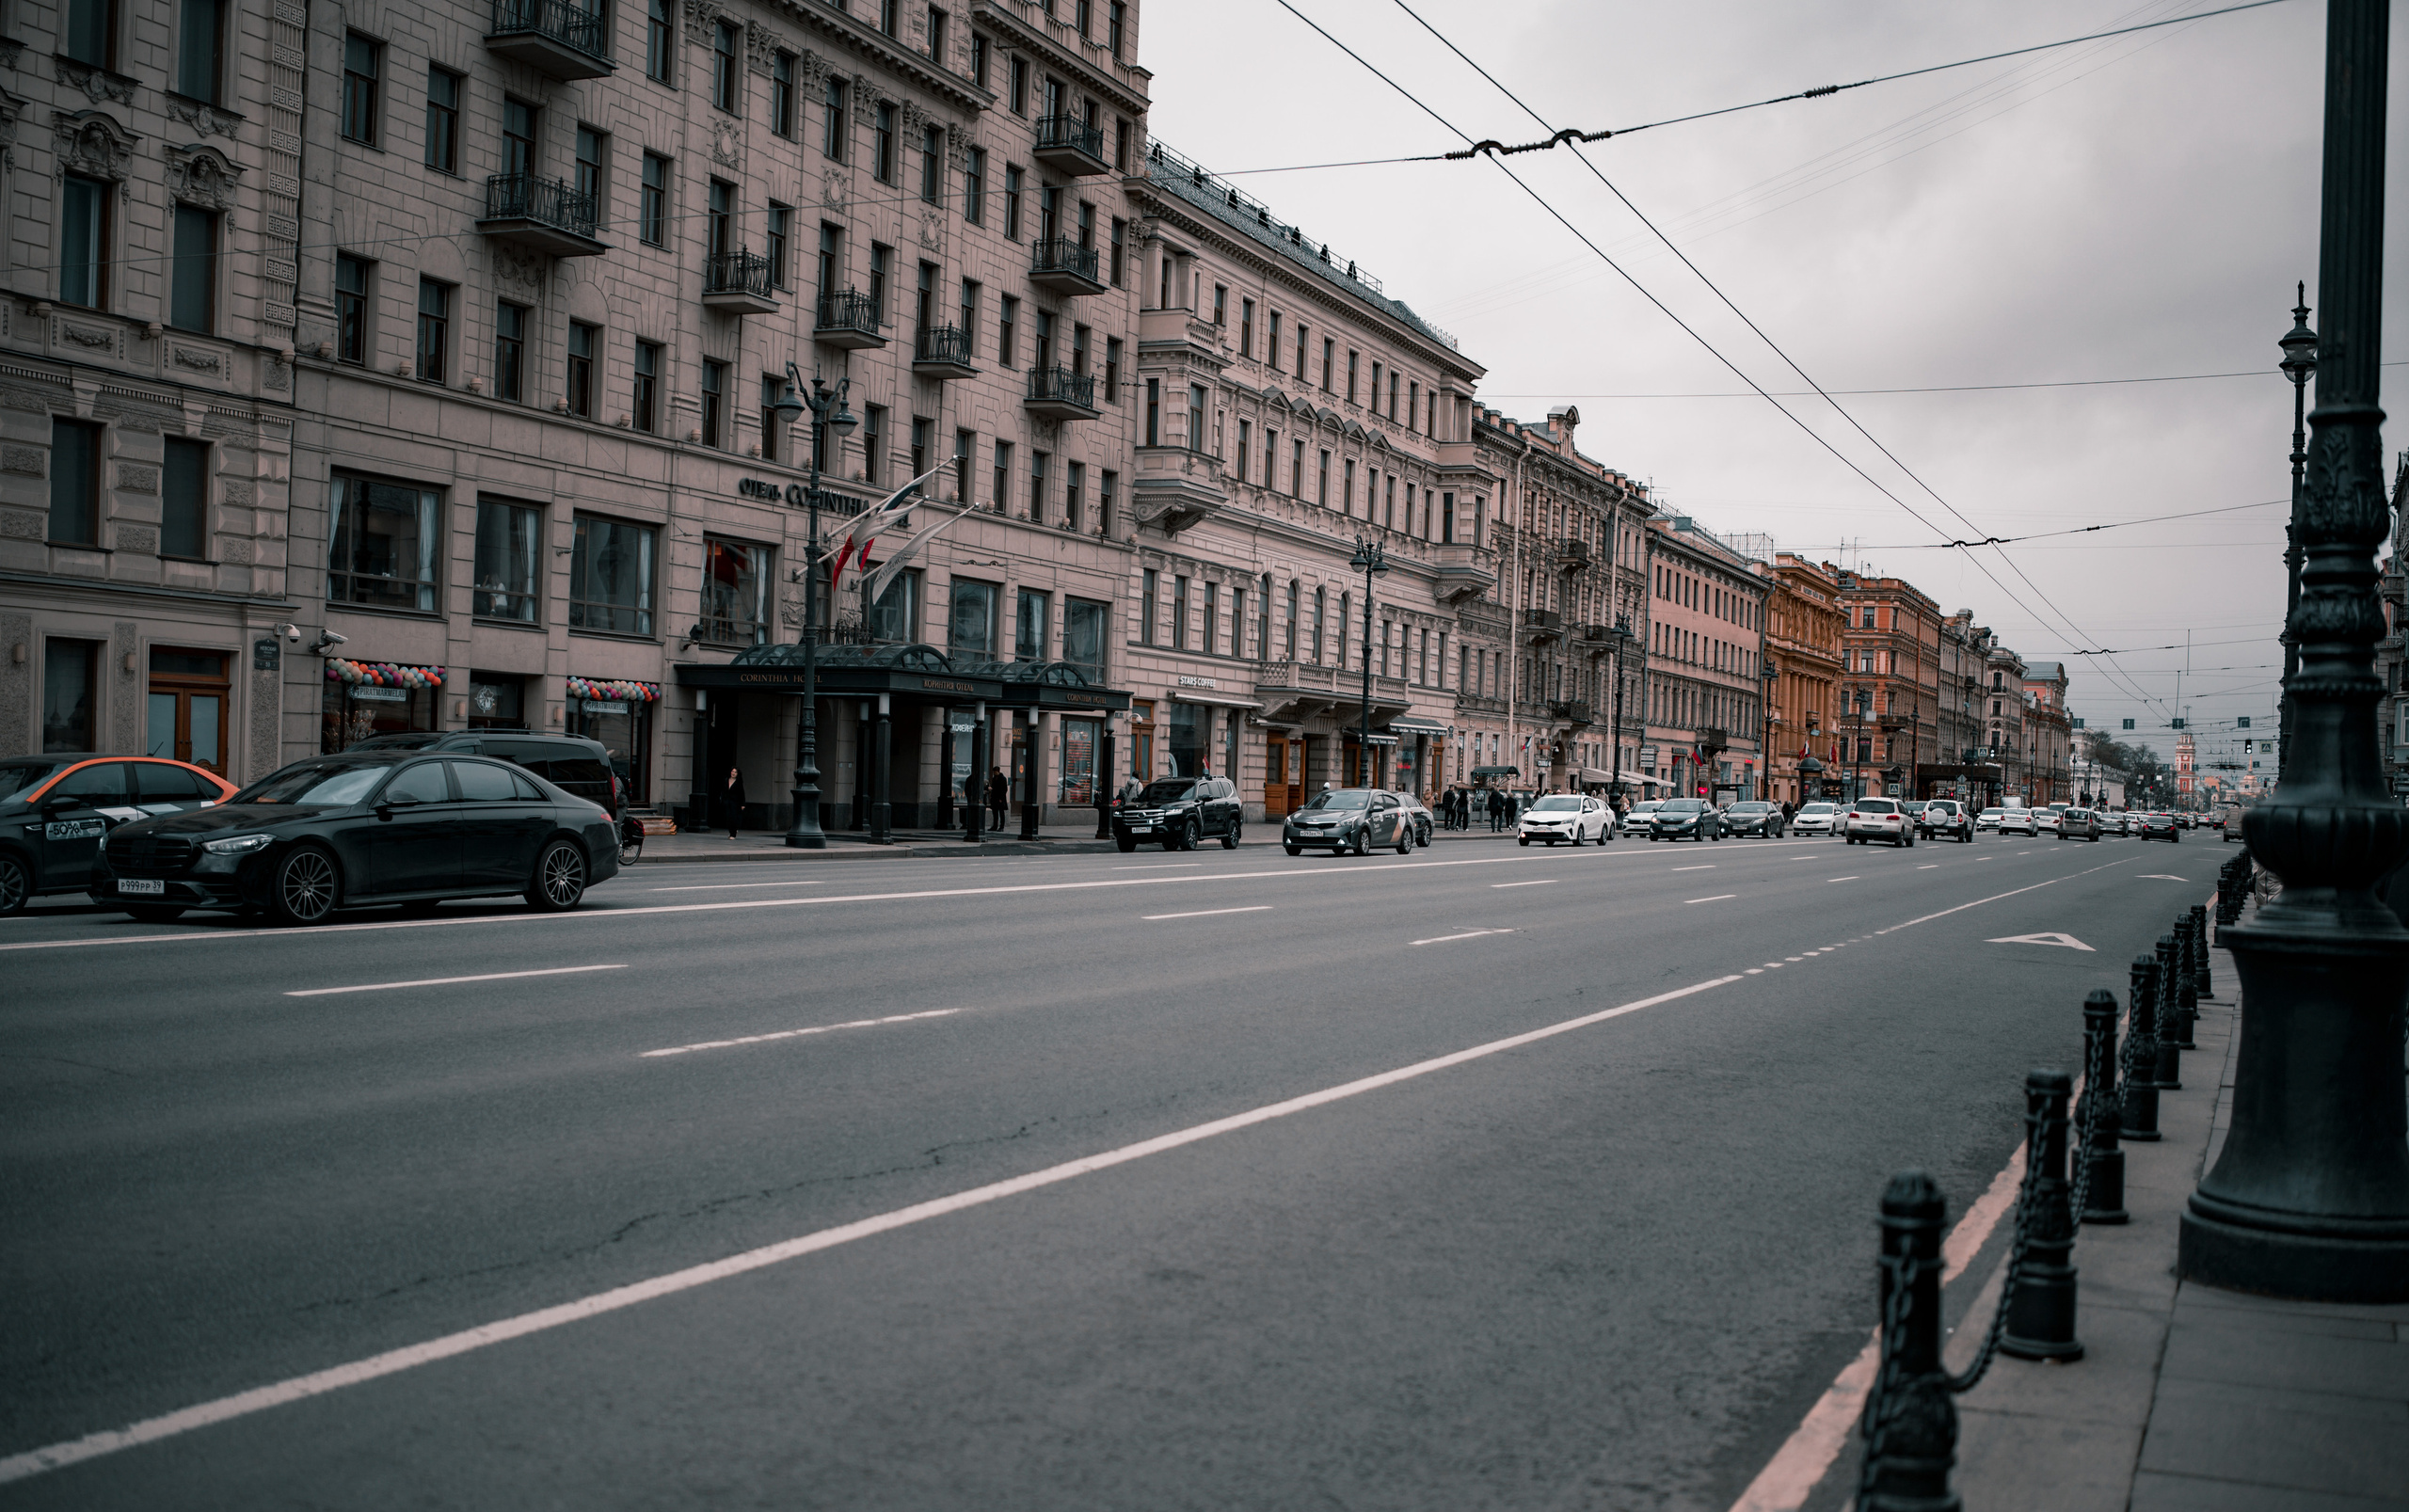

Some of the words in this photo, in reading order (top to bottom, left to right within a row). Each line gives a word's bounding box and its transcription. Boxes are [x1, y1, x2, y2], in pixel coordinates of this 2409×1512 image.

[739, 477, 782, 500] ОТЕЛЬ
[785, 483, 870, 518] COINTHIA
[740, 674, 789, 682] CORINTHIA
[793, 675, 822, 683] HOEL
[1180, 676, 1197, 686] STARS
[1197, 677, 1217, 688] COFFEE
[923, 679, 954, 690] КОРИНТИЯ
[956, 682, 974, 692] ОТЕЛЬ
[359, 687, 406, 698] PIRATMARMELAD
[48, 822, 80, 836] -50%
